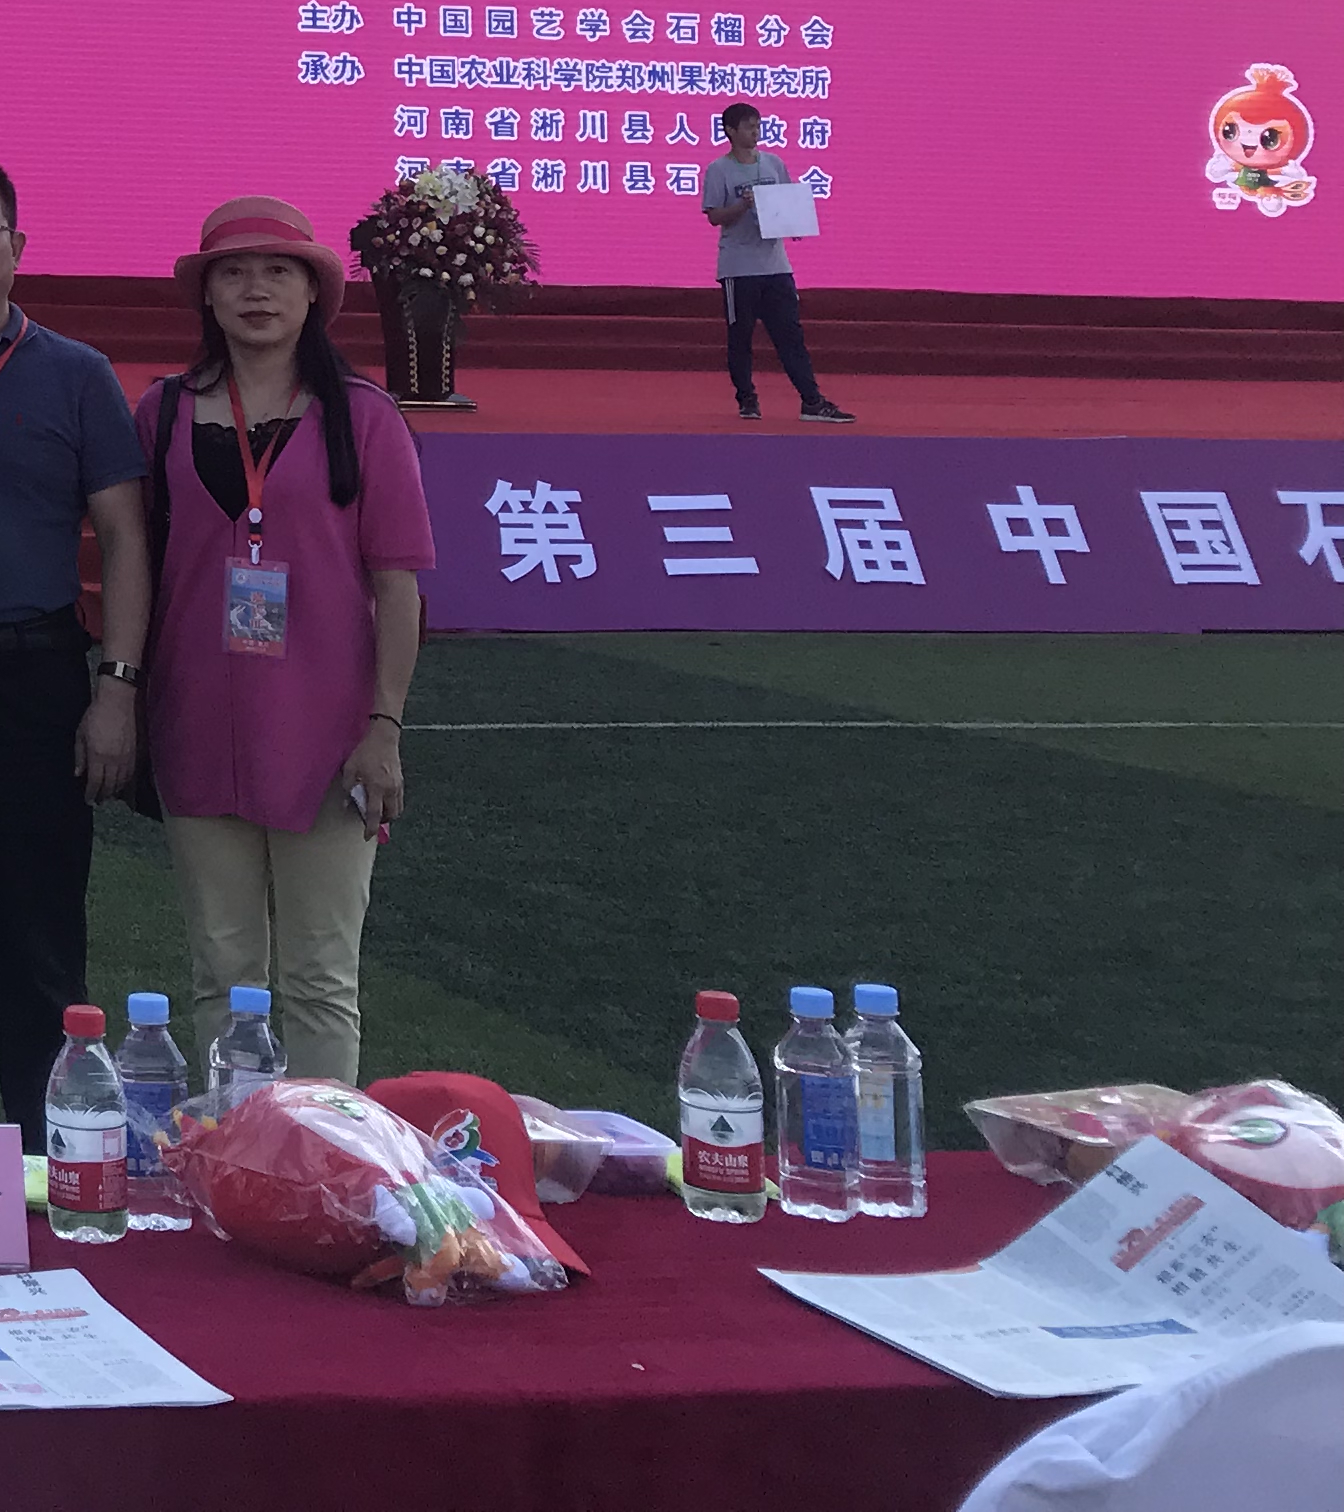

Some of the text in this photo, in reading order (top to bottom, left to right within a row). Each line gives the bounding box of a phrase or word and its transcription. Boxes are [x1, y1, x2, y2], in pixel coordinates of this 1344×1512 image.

[298, 1, 834, 49] 主办 中国园艺学会石榴分会
[298, 53, 831, 100] 承办 中国农业科学院郑州果树研究所
[485, 476, 1344, 585] 第三届中国石
[698, 1149, 749, 1168] 农夫山泉
